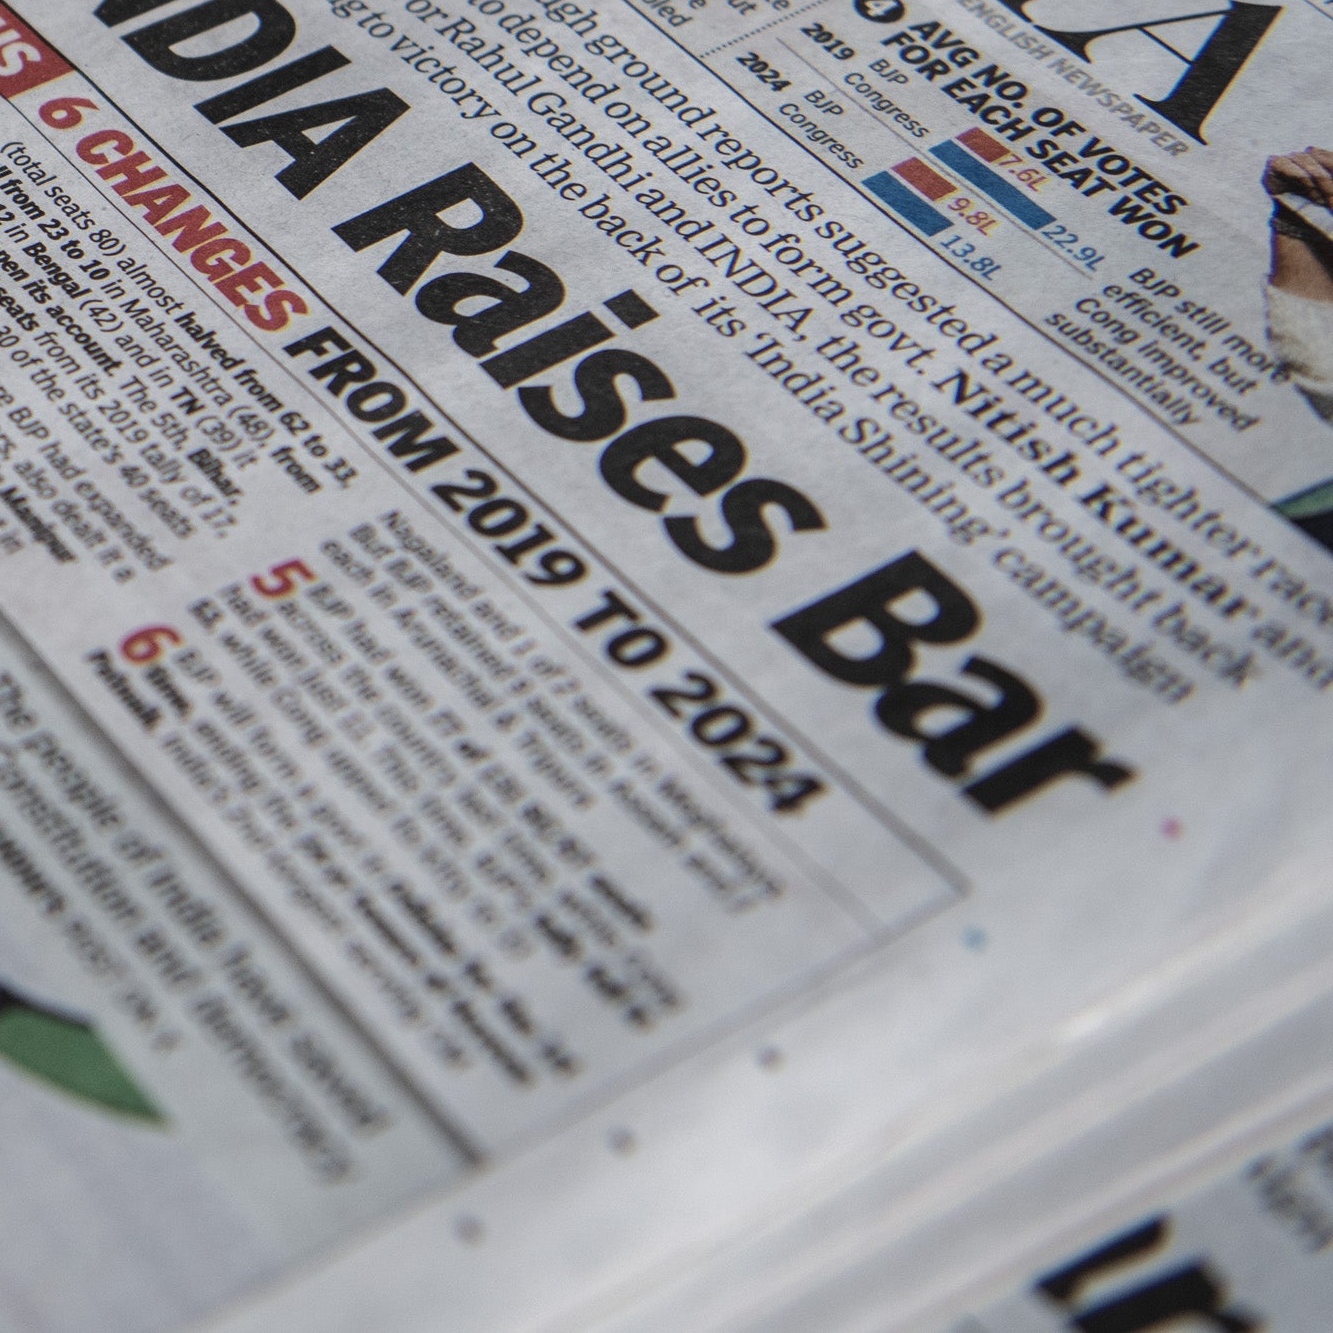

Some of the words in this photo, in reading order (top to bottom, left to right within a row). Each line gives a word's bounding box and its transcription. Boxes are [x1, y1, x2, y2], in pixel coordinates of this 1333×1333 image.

[735, 52, 792, 92] 2024
[800, 22, 855, 61] 2019
[868, 58, 909, 85] BJP
[778, 103, 864, 169] Congress
[803, 90, 844, 116] BJP
[843, 72, 929, 138] Congress
[880, 31, 951, 82] FOR
[940, 77, 1036, 142] EACH
[1024, 139, 1117, 197] SEAT
[1107, 195, 1201, 259] WON
[907, 21, 980, 69] AVG
[970, 64, 1028, 109] NO.
[1031, 107, 1087, 138] OF
[1077, 136, 1188, 216] VOTES
[1046, 57, 1189, 157] NEWSPAPER
[357, 12, 394, 39] to
[389, 34, 501, 120] victory
[489, 122, 537, 159] on
[528, 153, 587, 202] the
[577, 193, 666, 267] back
[655, 264, 710, 297] of
[690, 296, 747, 338] its
[583, 34, 716, 129] ground
[695, 123, 825, 223] reports
[813, 221, 998, 357] suggested
[980, 353, 1013, 376] a
[946, 197, 996, 237] 9.8L
[997, 151, 1048, 192] 7.6L
[433, 16, 542, 97] Rahul
[526, 91, 653, 193] Gandhi
[634, 188, 715, 243] and
[693, 233, 813, 342] INDIA,
[815, 336, 880, 387] the
[868, 384, 1004, 488] results
[939, 235, 1001, 282] 13.8L
[1040, 223, 1107, 274] 22.9L
[21, 279, 52, 305] its
[44, 305, 122, 378] account.
[497, 14, 620, 105] depend
[603, 101, 651, 139] on
[641, 135, 737, 208] allies
[728, 204, 770, 237] to
[758, 233, 853, 308] form
[839, 304, 935, 375] govt.
[931, 369, 1080, 487] Nitish
[1078, 484, 1262, 623] Kumar
[1044, 313, 1200, 426] substantially
[1074, 298, 1141, 346] Cong
[1137, 340, 1260, 433] improved
[1102, 285, 1206, 362] efficient,
[1207, 357, 1258, 396] but
[1128, 268, 1181, 298] BJP
[1174, 301, 1231, 335] still
[1222, 334, 1294, 384] more
[37, 97, 99, 130] 6
[74, 129, 307, 332] CHANGES
[281, 326, 461, 474] FROM
[429, 469, 588, 588] 2019
[573, 590, 670, 670] TO
[648, 672, 827, 816] 2024
[329, 161, 827, 577] Raises
[768, 550, 1136, 817] Bar
